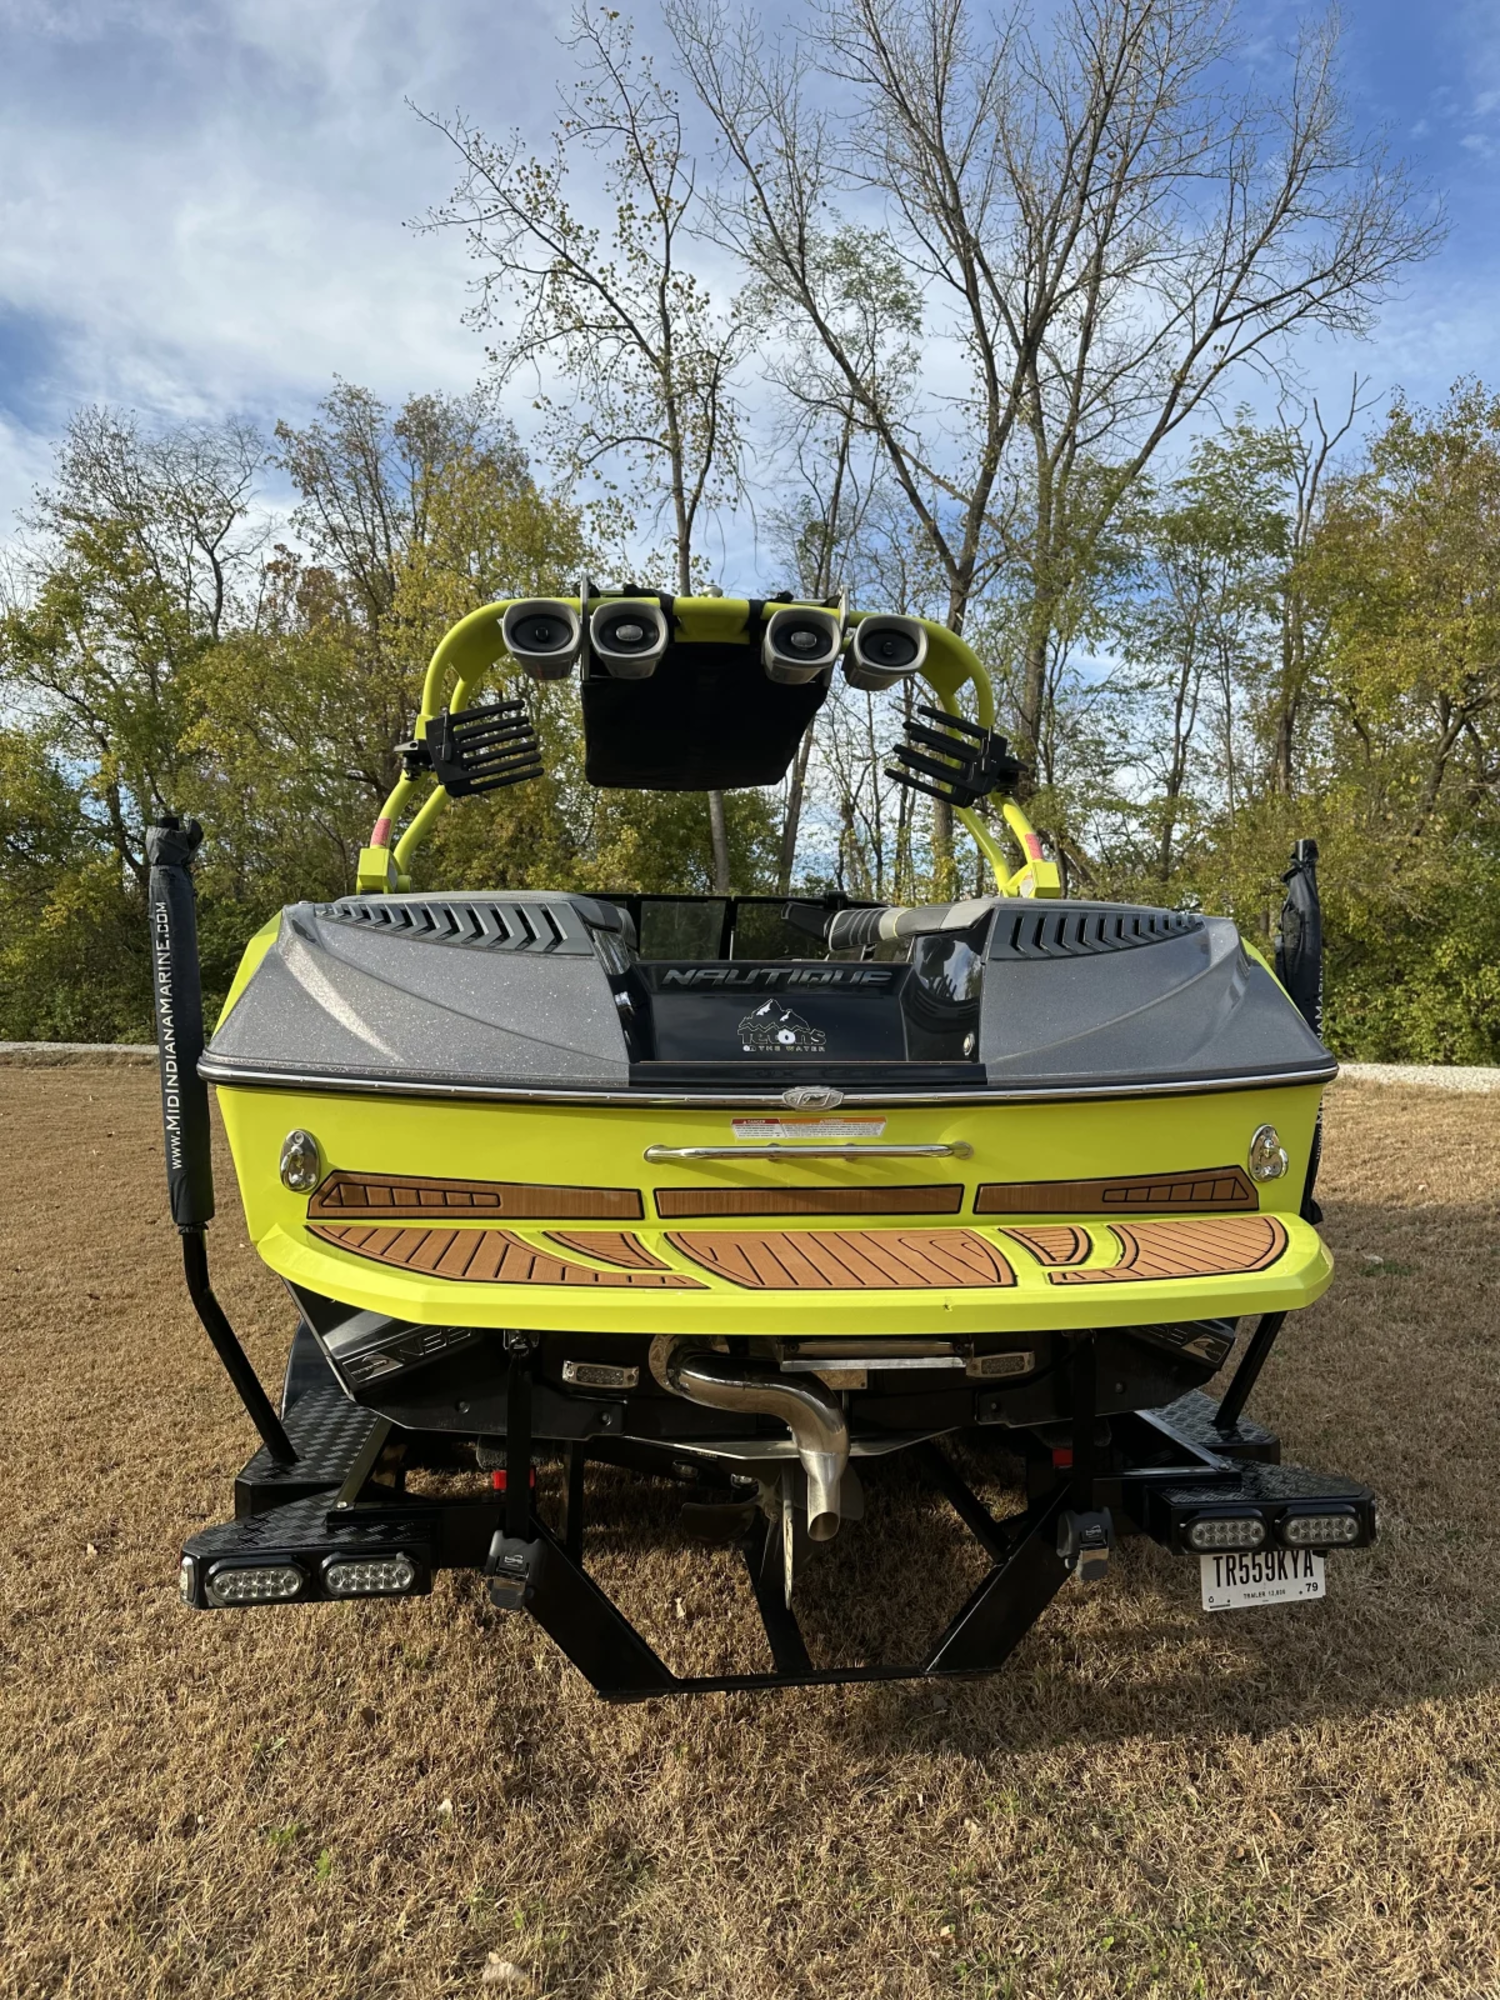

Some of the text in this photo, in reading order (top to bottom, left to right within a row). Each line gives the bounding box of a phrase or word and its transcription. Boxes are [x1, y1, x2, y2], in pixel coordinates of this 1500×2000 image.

[661, 968, 893, 986] NAUTIQUE
[155, 901, 182, 1169] www.MIDINDIANAMARINE.COM
[1212, 1551, 1314, 1588] TR559KYA
[1243, 1591, 1266, 1599] TRAILER
[1305, 1582, 1319, 1592] 79
